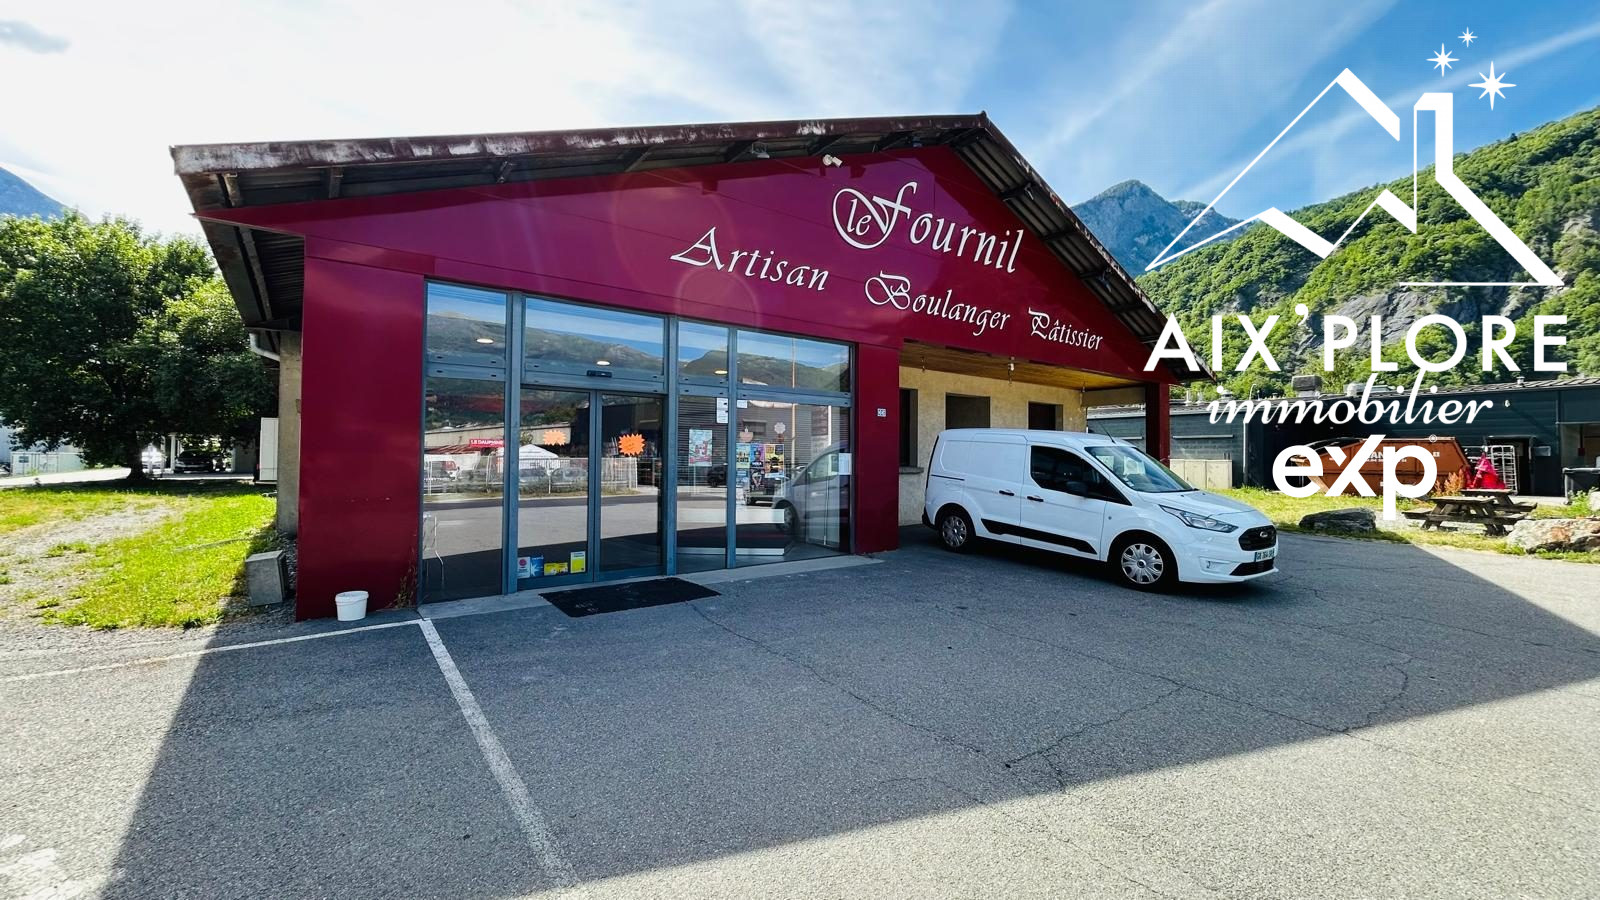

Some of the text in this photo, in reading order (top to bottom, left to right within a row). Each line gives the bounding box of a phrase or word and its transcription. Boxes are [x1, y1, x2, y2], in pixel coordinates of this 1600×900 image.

[832, 181, 1024, 274] Fournil
[670, 226, 1103, 351] Artisan Boulanger Pâtissier
